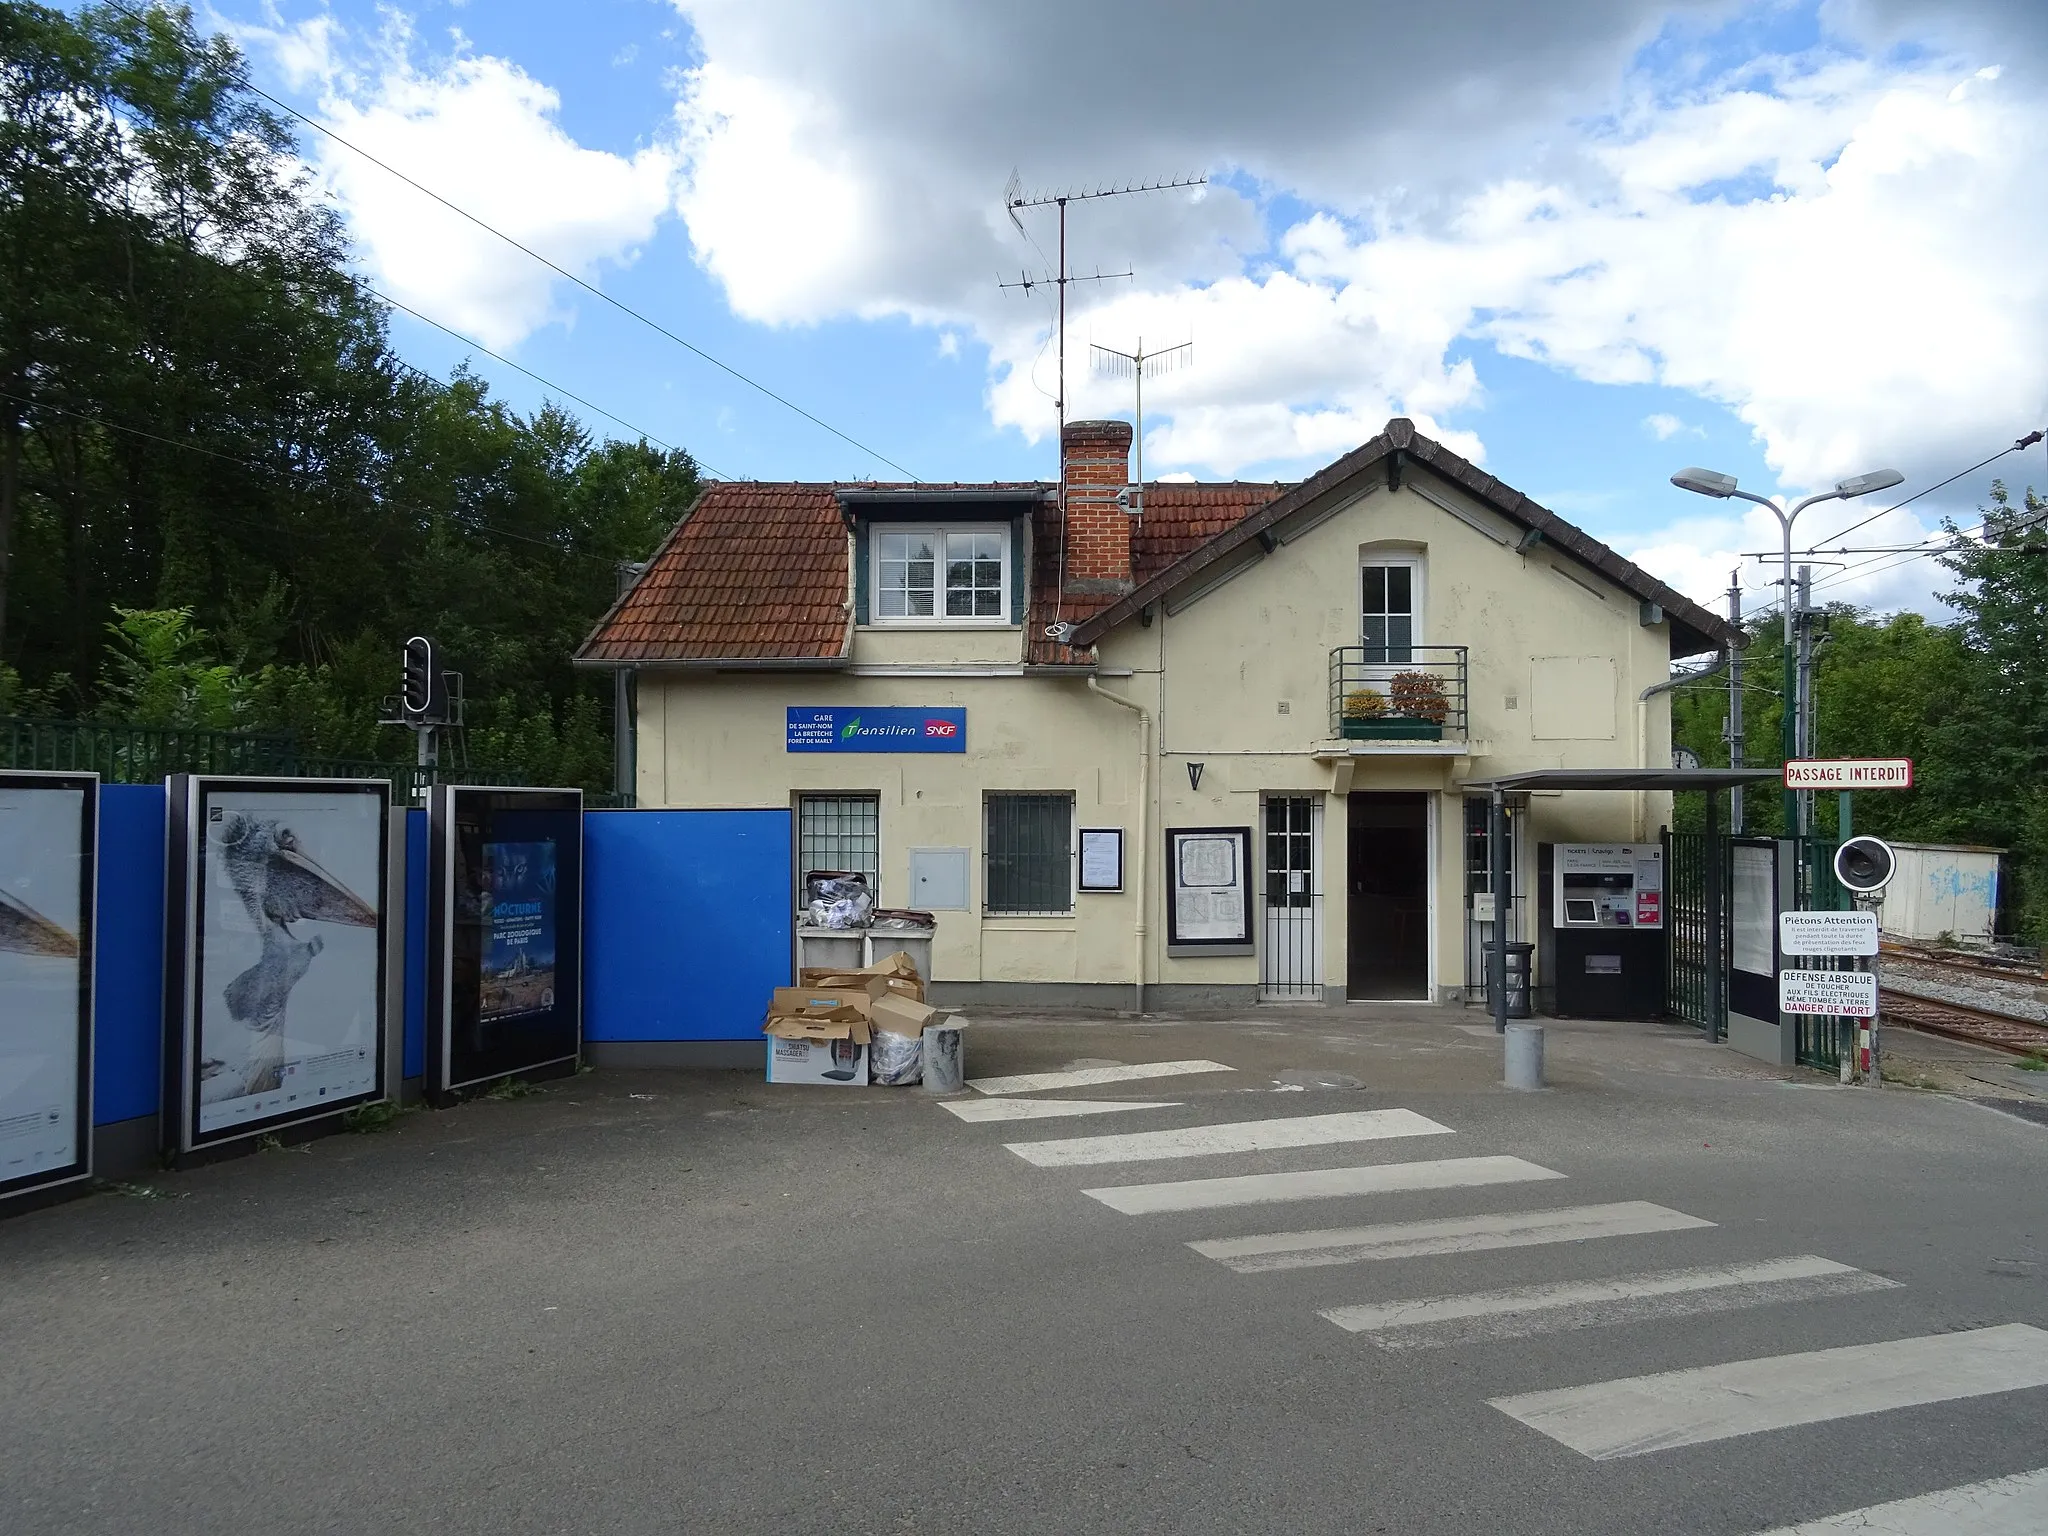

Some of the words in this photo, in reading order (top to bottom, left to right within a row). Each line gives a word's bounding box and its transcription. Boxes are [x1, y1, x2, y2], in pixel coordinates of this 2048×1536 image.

[814, 714, 833, 722] GARE
[847, 724, 916, 737] Transilien
[925, 725, 956, 736] SNCF
[1788, 768, 1843, 781] PASSAGE
[1850, 767, 1907, 780] INTERDIT
[494, 903, 542, 917] NOCTURNE
[1784, 916, 1822, 925] Piétons
[1824, 916, 1873, 925] Attention
[493, 931, 507, 940] PARC
[508, 928, 542, 938] ZOOLOGIQUE
[506, 938, 514, 946] DE
[514, 937, 529, 945] PARIS
[1784, 971, 1826, 982] DÉFENSE
[1828, 974, 1872, 985] ABSOLUE
[1817, 983, 1850, 991] TOUCHER
[1846, 998, 1869, 1006] TERRE
[1784, 1002, 1824, 1012] DANGER
[1827, 1005, 1840, 1013] DE
[1842, 1006, 1871, 1015] MORT
